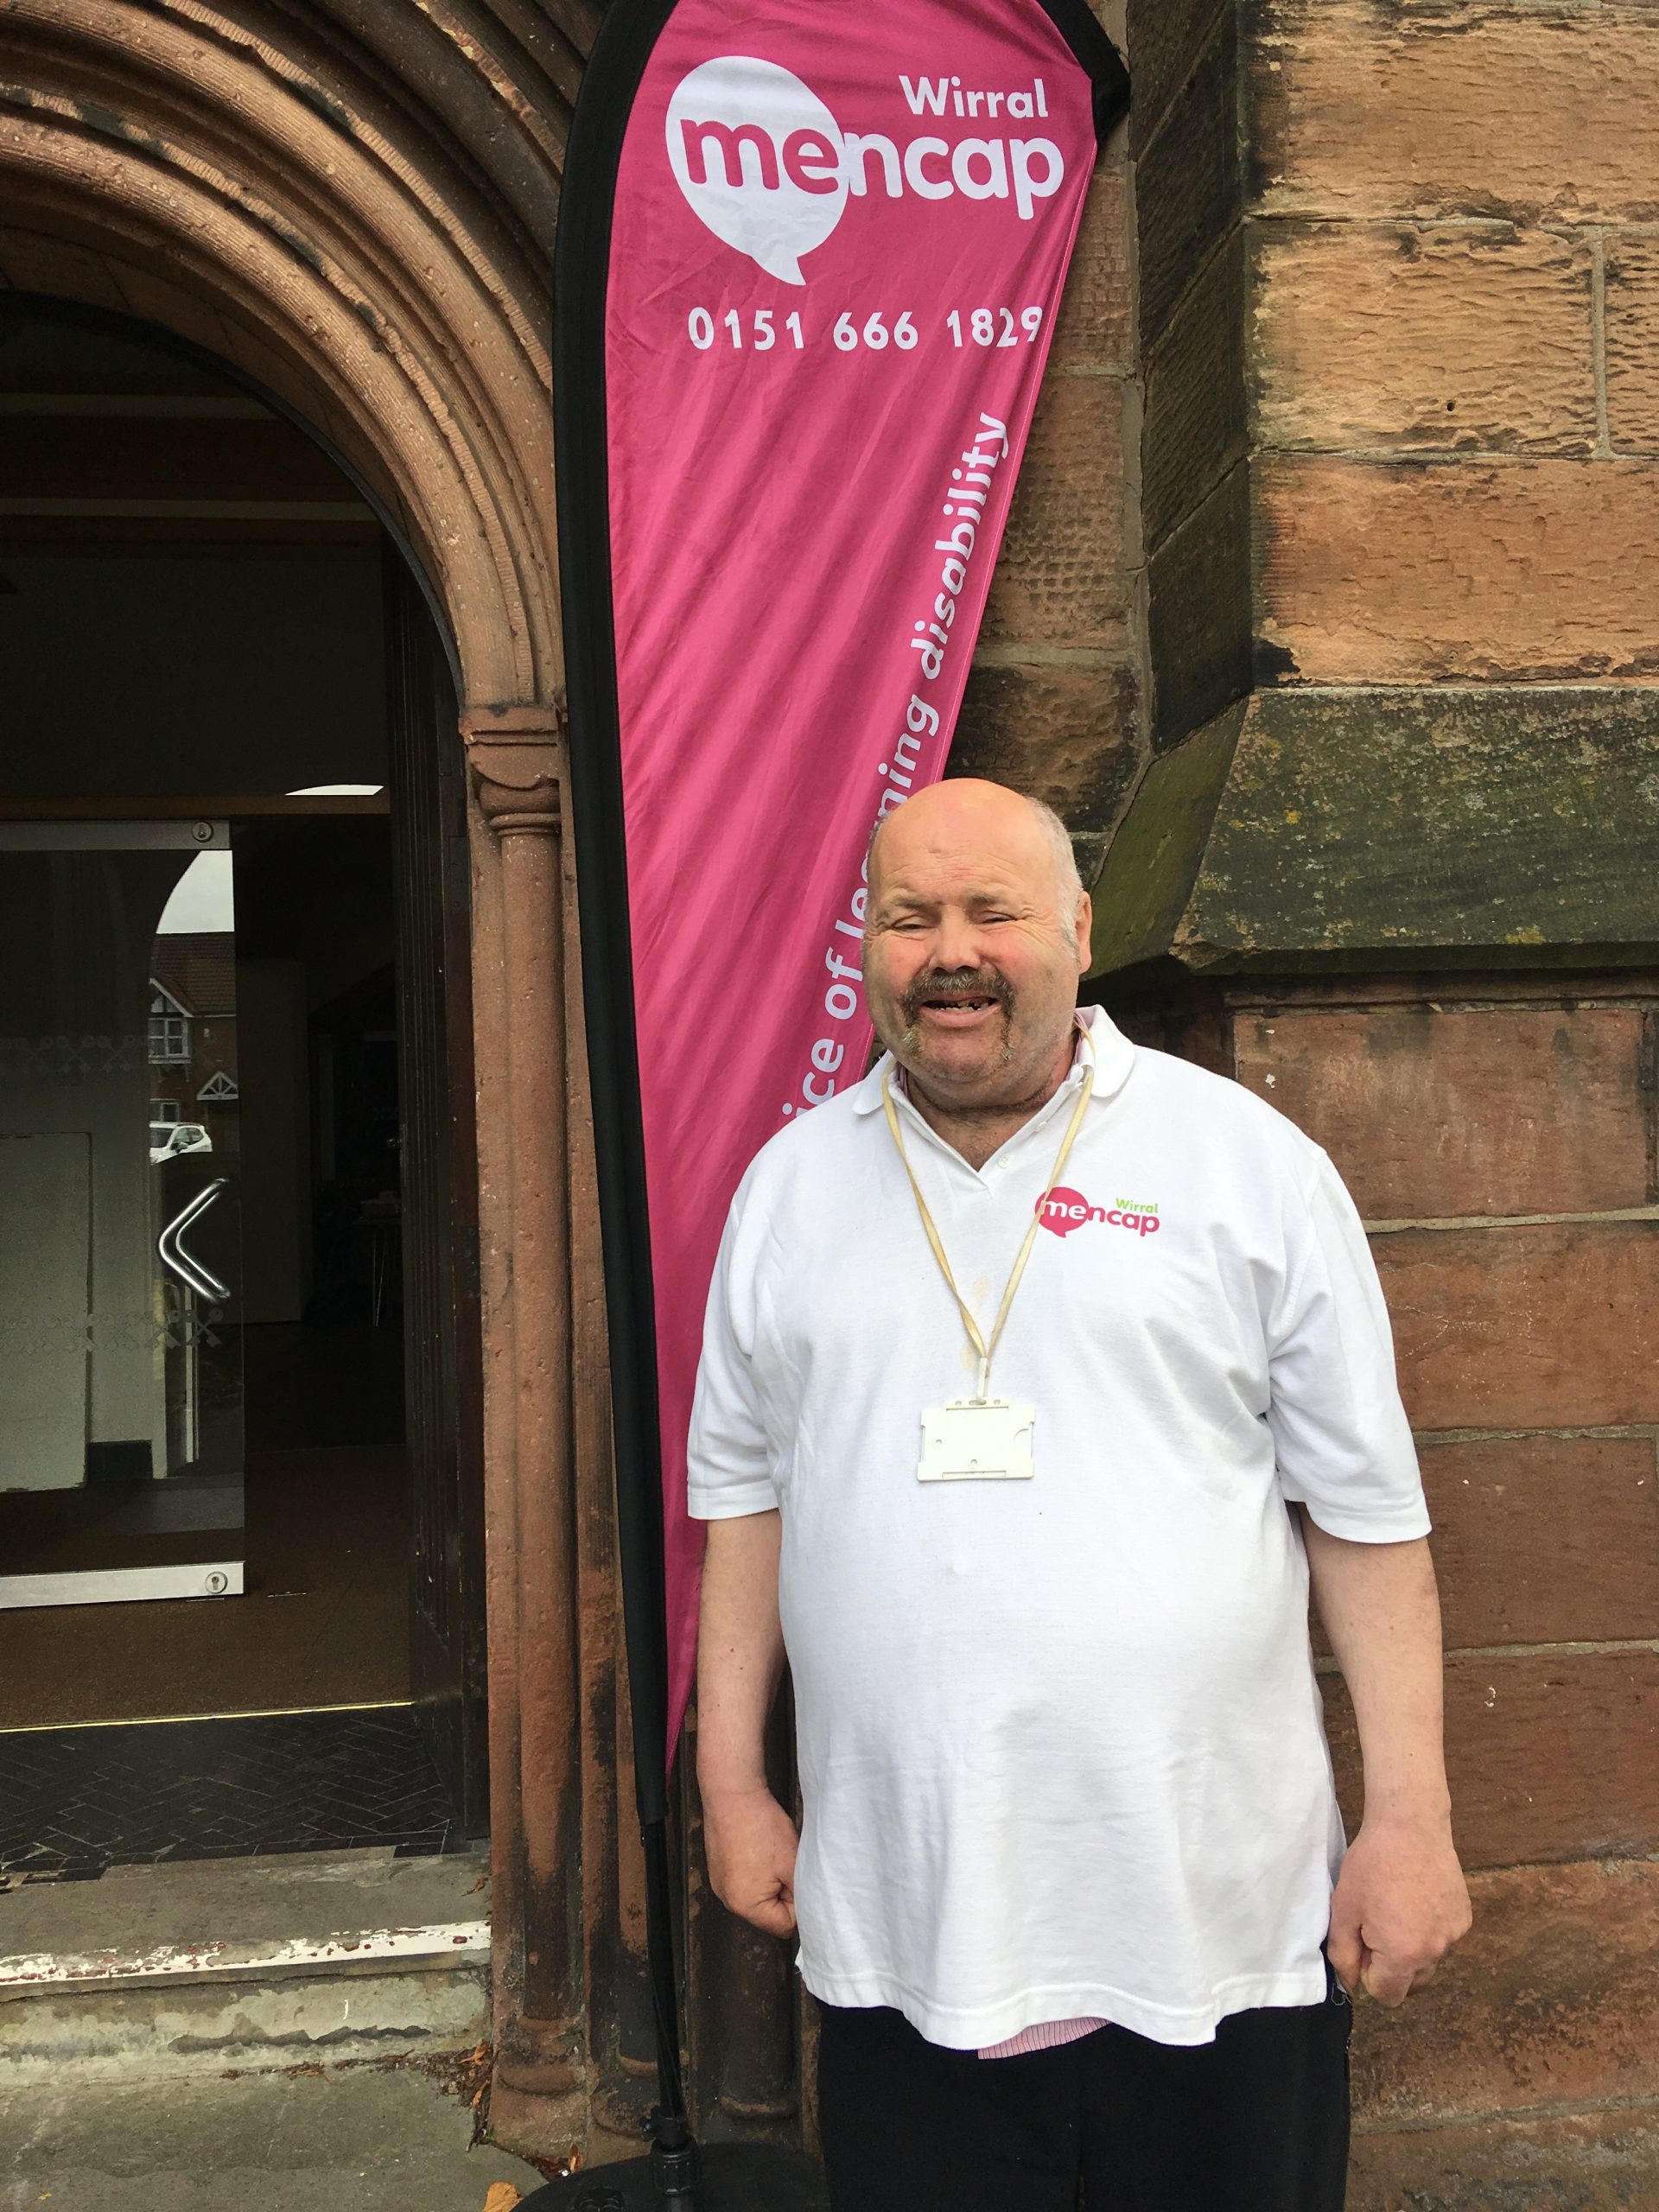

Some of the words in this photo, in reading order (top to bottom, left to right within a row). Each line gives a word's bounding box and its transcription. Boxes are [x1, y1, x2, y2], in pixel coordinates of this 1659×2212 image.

[899, 75, 1048, 118] Wirral
[680, 119, 1064, 219] mencap
[689, 307, 804, 350] 0151
[833, 311, 918, 351] 666
[947, 306, 1043, 347] 1829
[825, 947, 862, 1020] of
[910, 412, 1008, 680] disability
[1040, 1199, 1160, 1236] mencap
[1116, 1198, 1159, 1214] Wirral
